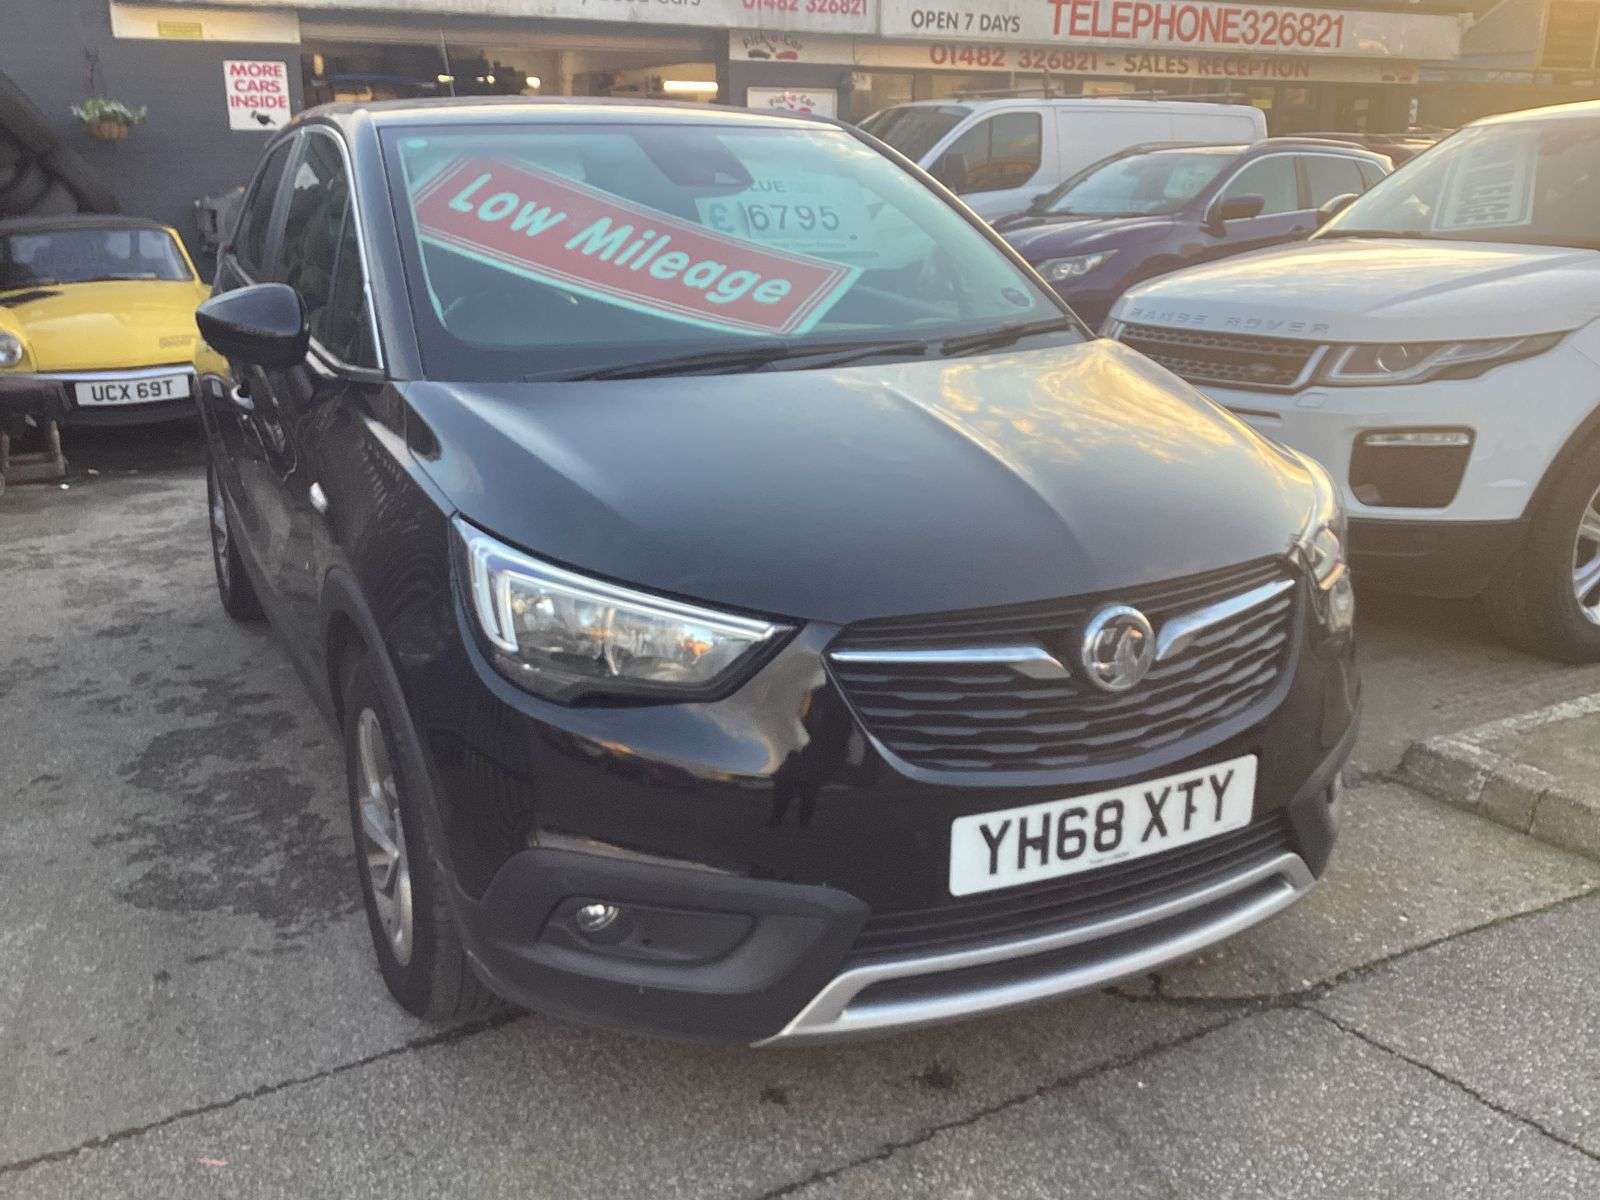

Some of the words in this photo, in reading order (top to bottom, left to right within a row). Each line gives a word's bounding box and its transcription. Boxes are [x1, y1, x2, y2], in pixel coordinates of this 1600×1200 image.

[805, 0, 867, 16] 326821
[911, 9, 959, 31] OPEN
[963, 14, 974, 31] 7
[979, 14, 1021, 33] DAYS
[1047, 0, 1345, 48] TELEPHONE326821
[229, 63, 283, 77] MORE
[929, 44, 1005, 68] 01482
[1018, 49, 1099, 72] 326821
[1123, 54, 1189, 75] SALES
[1197, 57, 1310, 78] RECEPTION
[234, 79, 281, 93] CARS
[229, 95, 287, 109] INSIDE
[748, 203, 841, 231] 6795
[447, 174, 566, 238] Low
[565, 216, 792, 306] Mileage
[91, 384, 132, 402] UCX
[136, 380, 175, 399] 69T
[979, 799, 1125, 876] YH68
[1141, 769, 1235, 843] XTY
